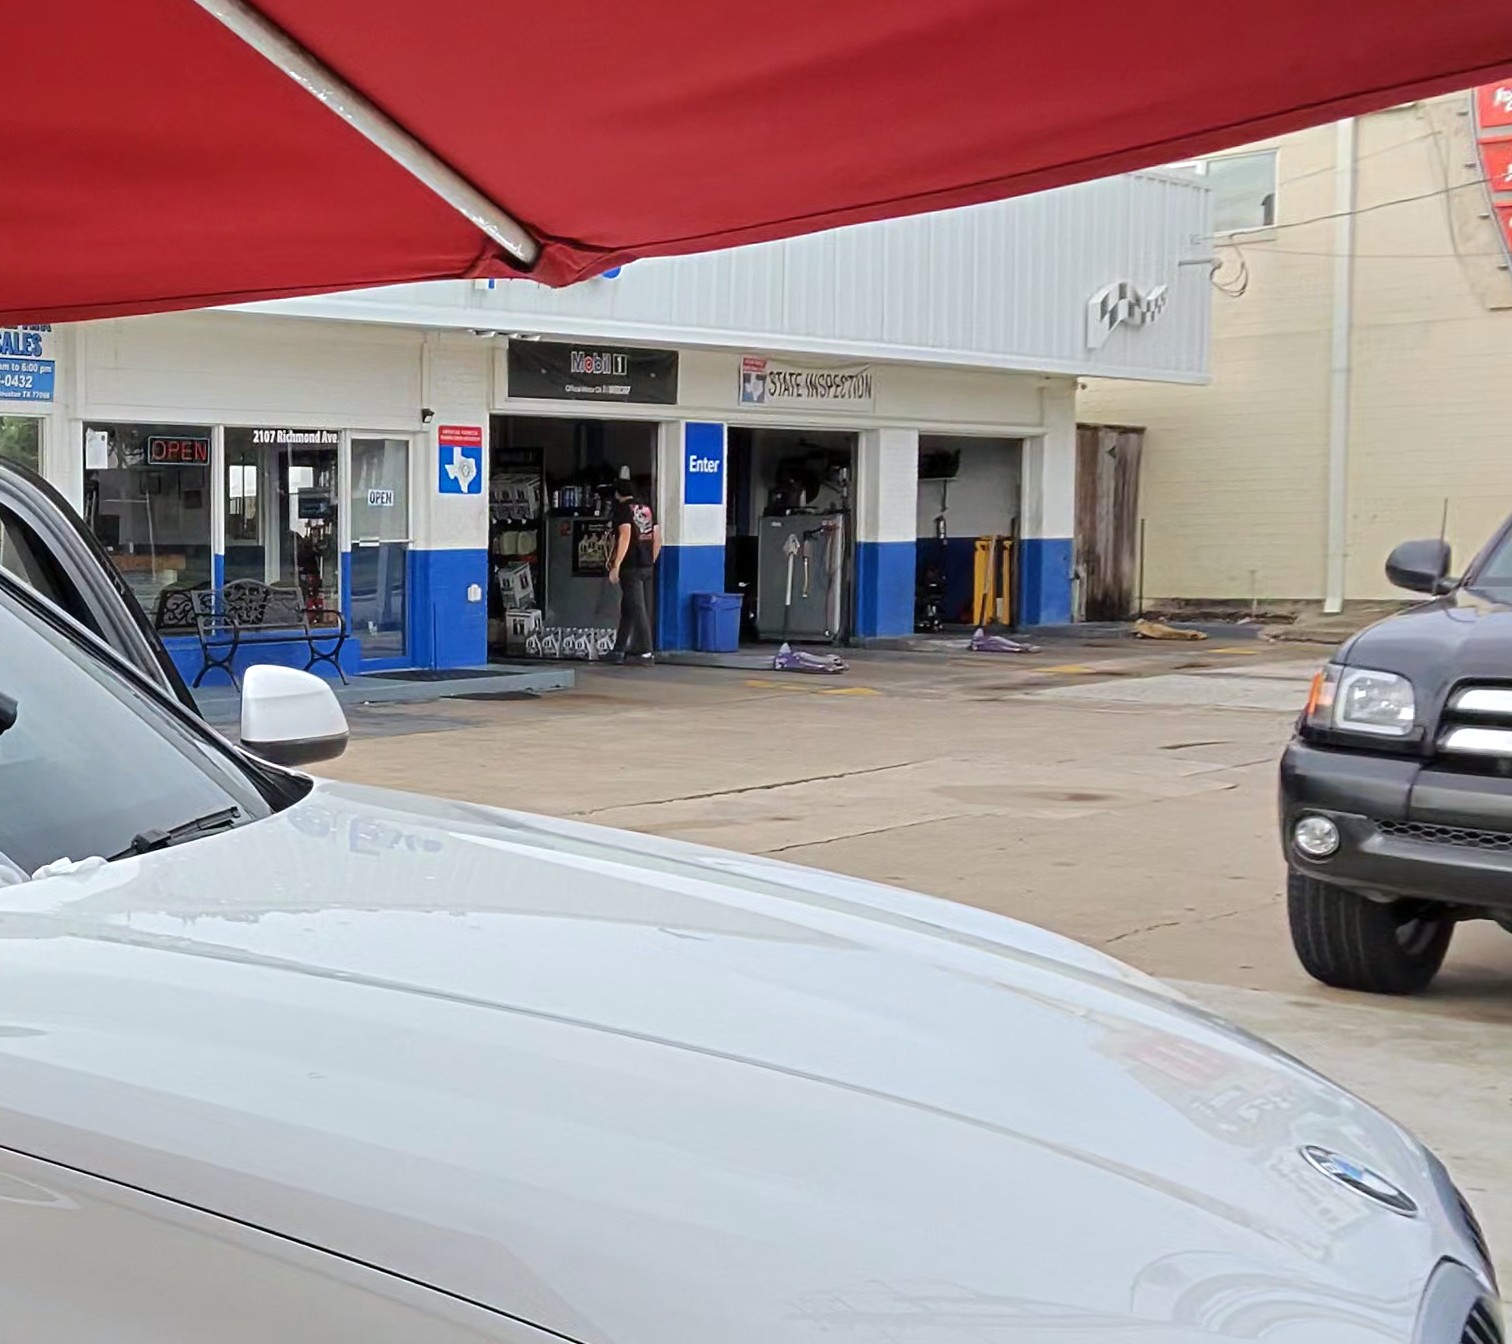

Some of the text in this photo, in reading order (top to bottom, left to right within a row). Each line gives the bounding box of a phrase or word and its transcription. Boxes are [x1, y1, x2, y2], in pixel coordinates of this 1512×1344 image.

[11, 363, 20, 372] to
[39, 365, 52, 374] pm
[571, 350, 611, 374] Mobil
[768, 371, 872, 399] STATE INSPECTION
[253, 429, 276, 443] 2107
[277, 429, 320, 444] Richmond
[152, 440, 207, 462] OPEN
[689, 455, 720, 473] Enter
[369, 491, 392, 505] OPEN
